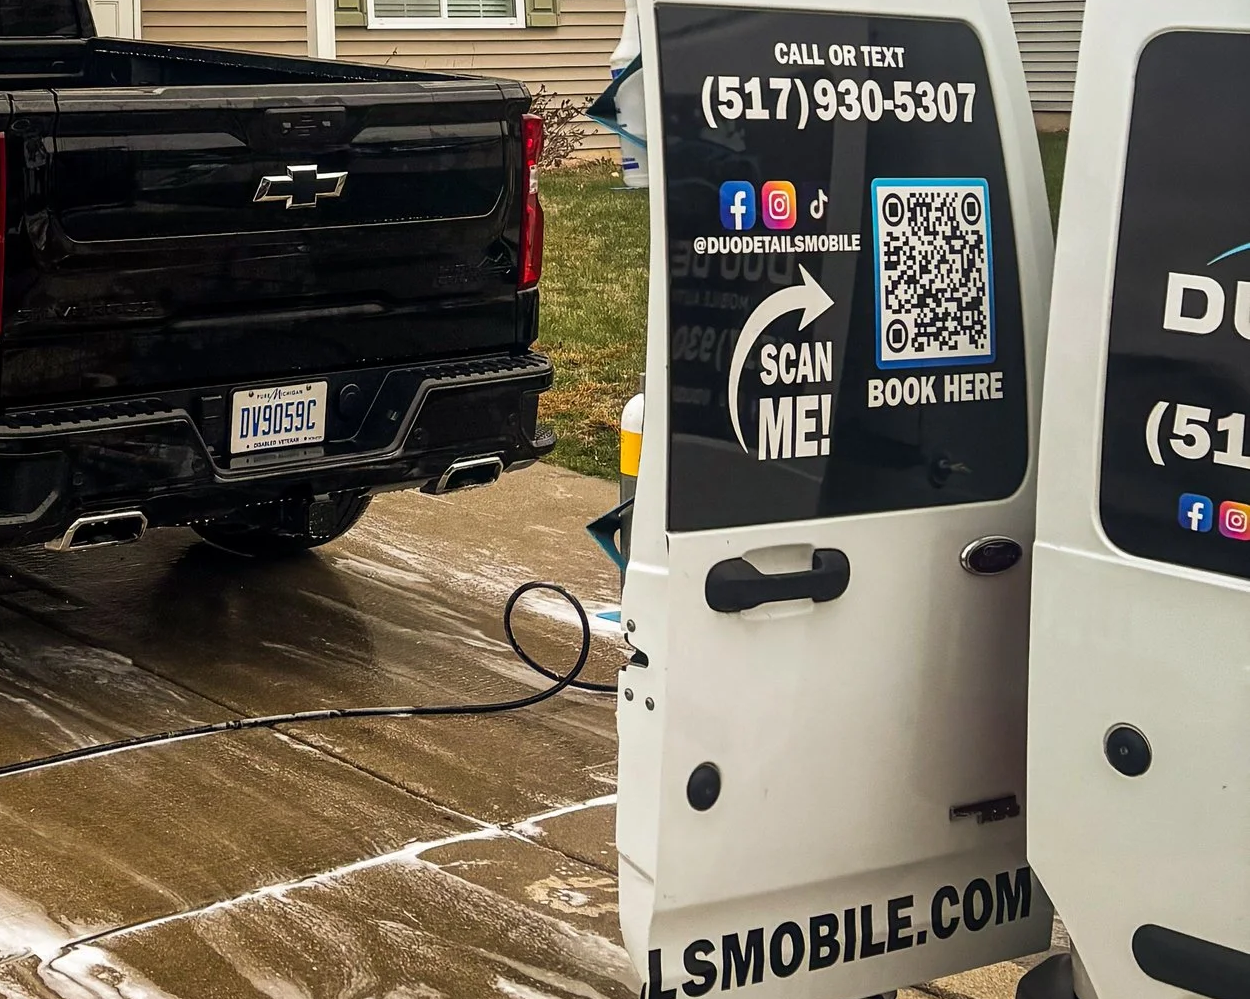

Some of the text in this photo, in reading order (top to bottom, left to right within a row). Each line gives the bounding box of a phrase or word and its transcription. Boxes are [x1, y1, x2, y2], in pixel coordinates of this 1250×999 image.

[774, 42, 905, 68] CALL OR TEXT
[693, 234, 861, 255] @DUODETAILSMOBILE
[1162, 271, 1250, 340] D
[759, 341, 833, 386] SCAN
[867, 371, 1004, 408] BOOK HERE
[240, 399, 317, 439] DV9059C
[758, 394, 832, 461] ME!
[640, 867, 1032, 999] LSMOBILE.COM
